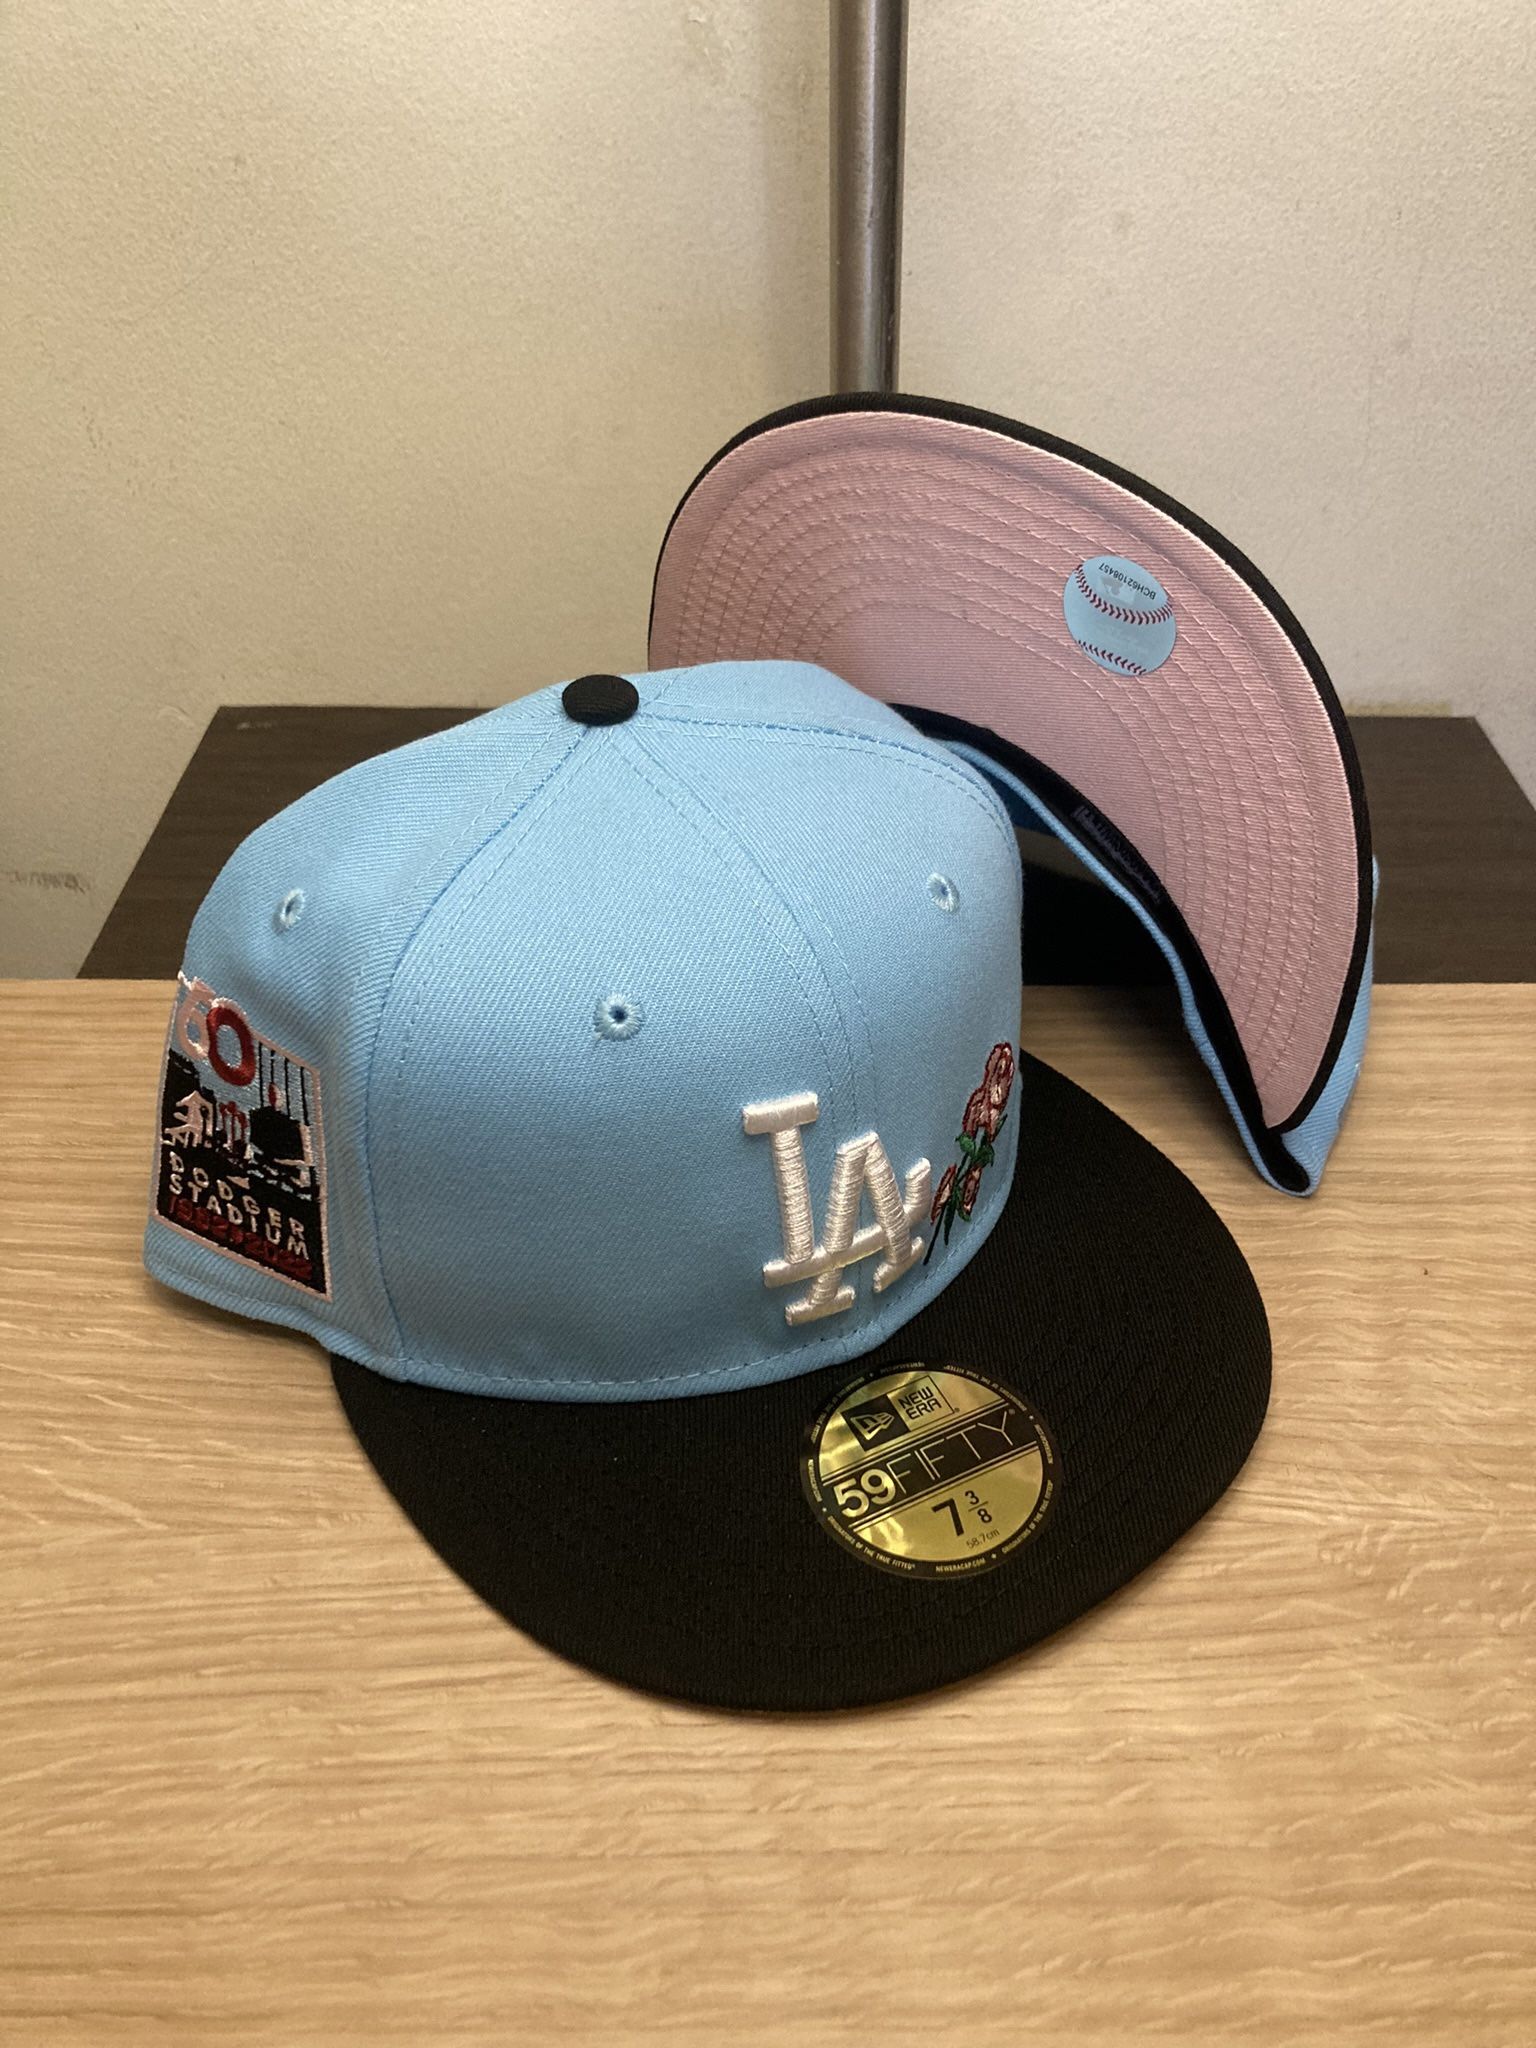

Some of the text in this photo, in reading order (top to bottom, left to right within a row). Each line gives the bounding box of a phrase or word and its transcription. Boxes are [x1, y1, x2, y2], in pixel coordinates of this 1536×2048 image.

[169, 1151, 305, 1241] DODGER
[169, 1173, 310, 1261] STADIUM
[741, 1089, 932, 1327] LA
[898, 1386, 934, 1411] NEW
[905, 1398, 943, 1421] ERA
[833, 1410, 1014, 1518] 59FIFTY
[931, 1498, 965, 1537] 7
[966, 1528, 1001, 1550] 58.7cm
